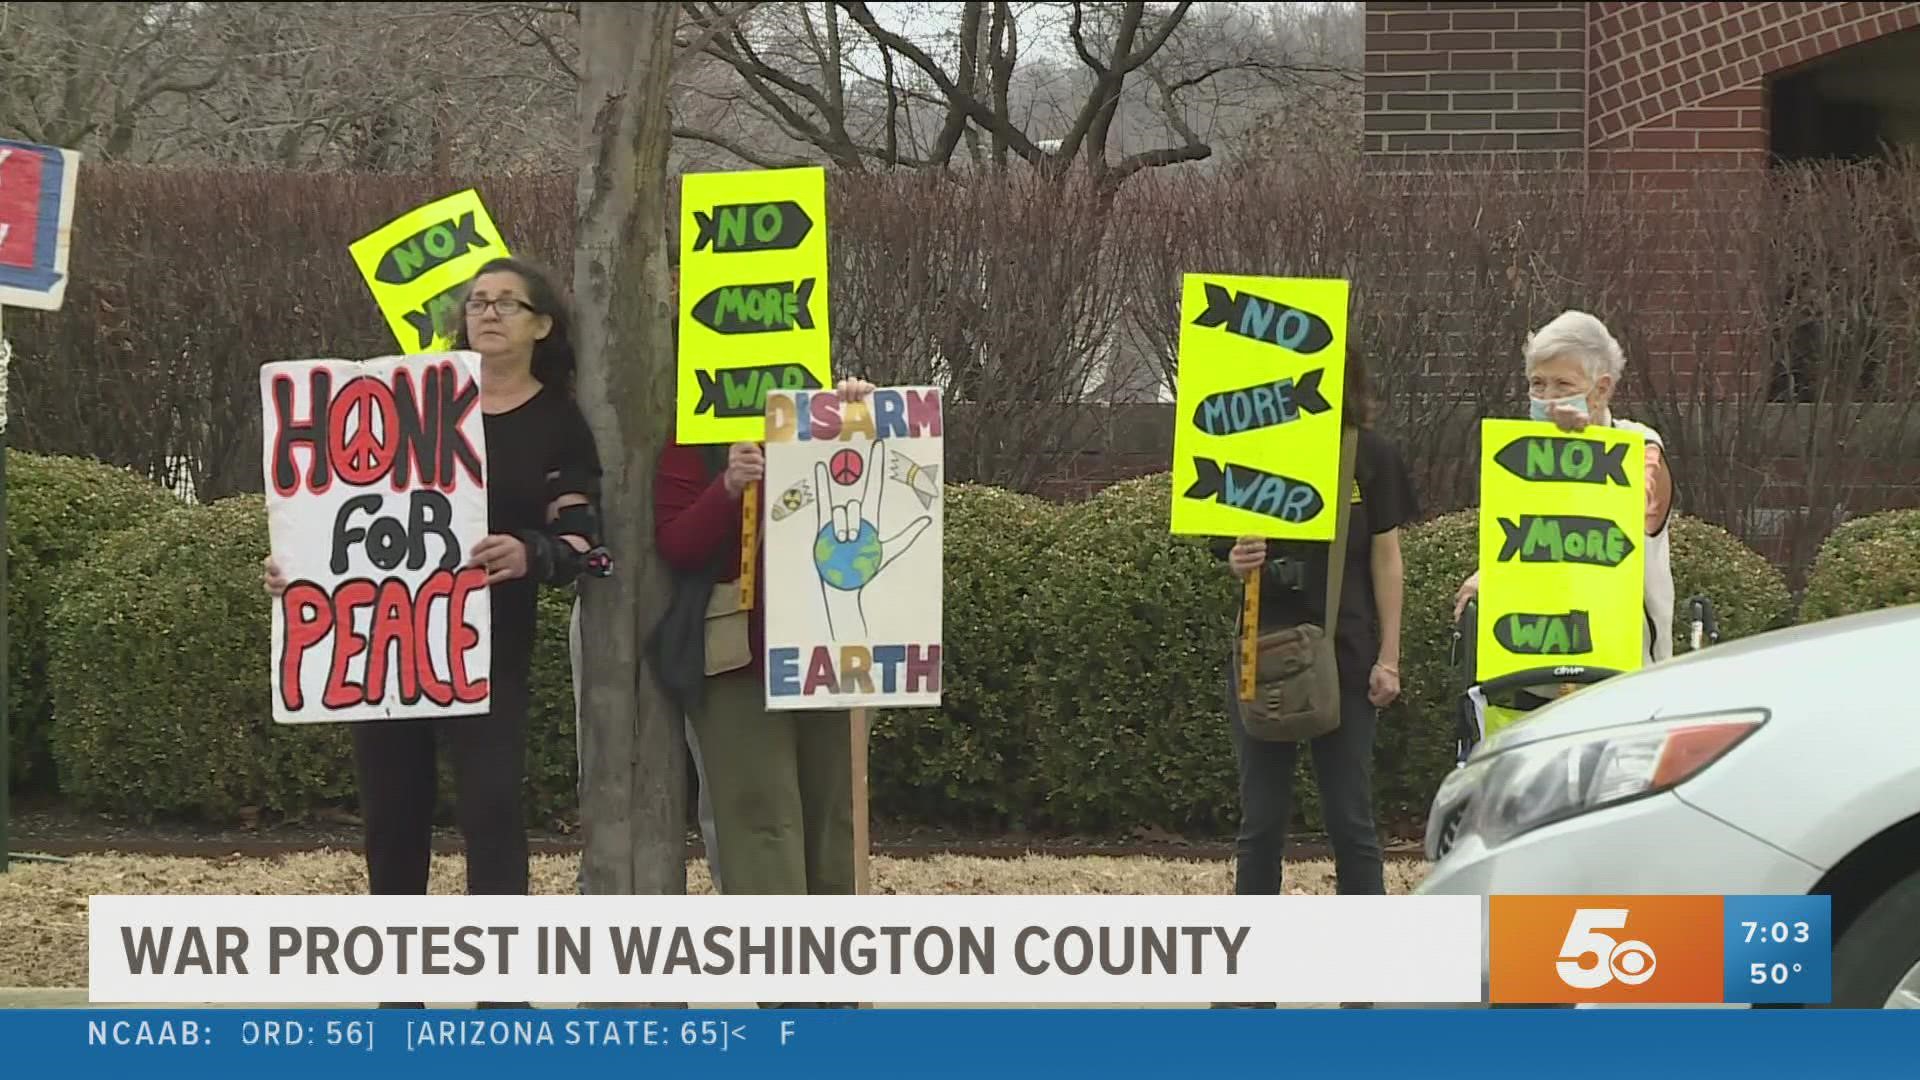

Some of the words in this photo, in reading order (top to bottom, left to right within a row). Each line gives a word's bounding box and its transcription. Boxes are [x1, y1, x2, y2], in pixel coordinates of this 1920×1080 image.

[392, 225, 456, 279] NO
[714, 205, 783, 248] NO
[714, 287, 798, 326] MORE
[1240, 296, 1310, 349] NO
[272, 361, 484, 497] HONK
[765, 389, 942, 442] DISARM
[1203, 377, 1299, 434] MORE
[1526, 438, 1594, 477] NO
[1225, 466, 1313, 523] WAR
[330, 489, 461, 575] FOR
[1522, 518, 1625, 561] MORE
[280, 569, 488, 711] PEACE
[768, 644, 941, 697] EARTH
